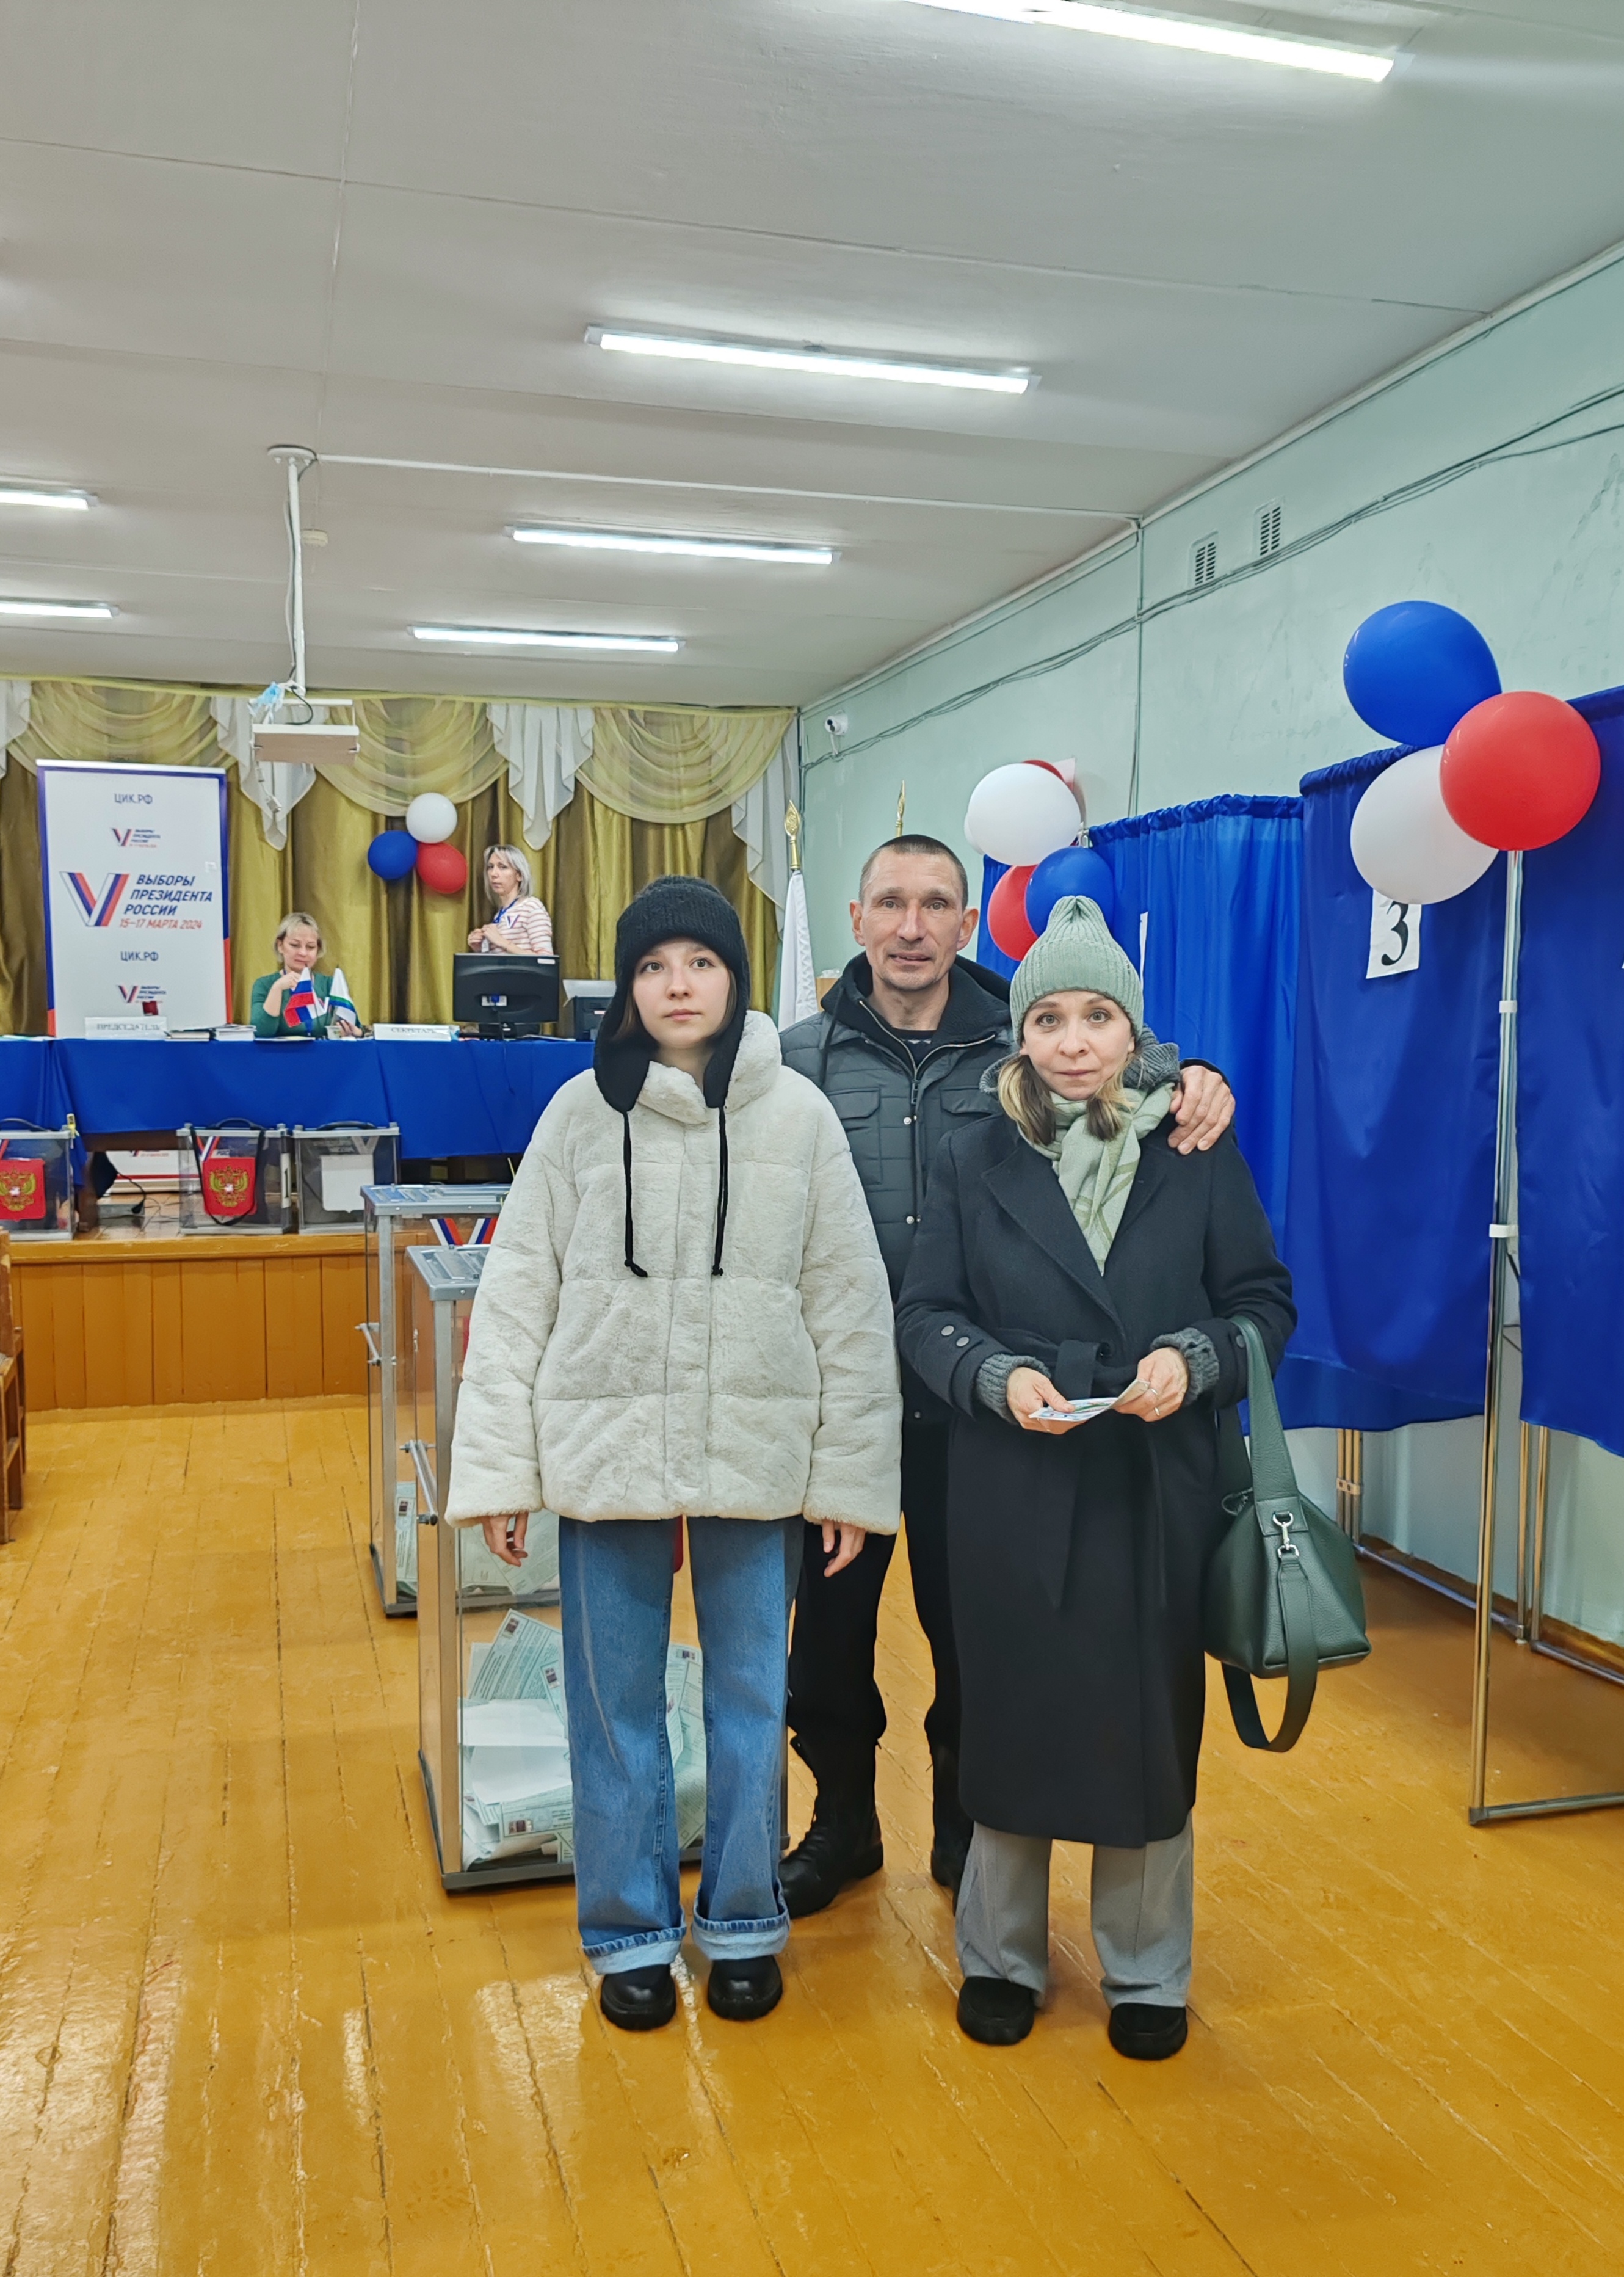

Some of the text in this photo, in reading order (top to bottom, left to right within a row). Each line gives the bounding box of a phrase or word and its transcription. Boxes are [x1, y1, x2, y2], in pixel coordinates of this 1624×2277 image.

[136, 875, 195, 886] ВЫБОРЫ
[130, 890, 212, 902] ПРЕЗИДЕНТА
[124, 904, 178, 916] РОССИИ
[147, 920, 178, 929] МАРТА
[180, 920, 202, 929] 2024
[1381, 901, 1408, 966] 3
[120, 951, 159, 962] ЦИК.РФ
